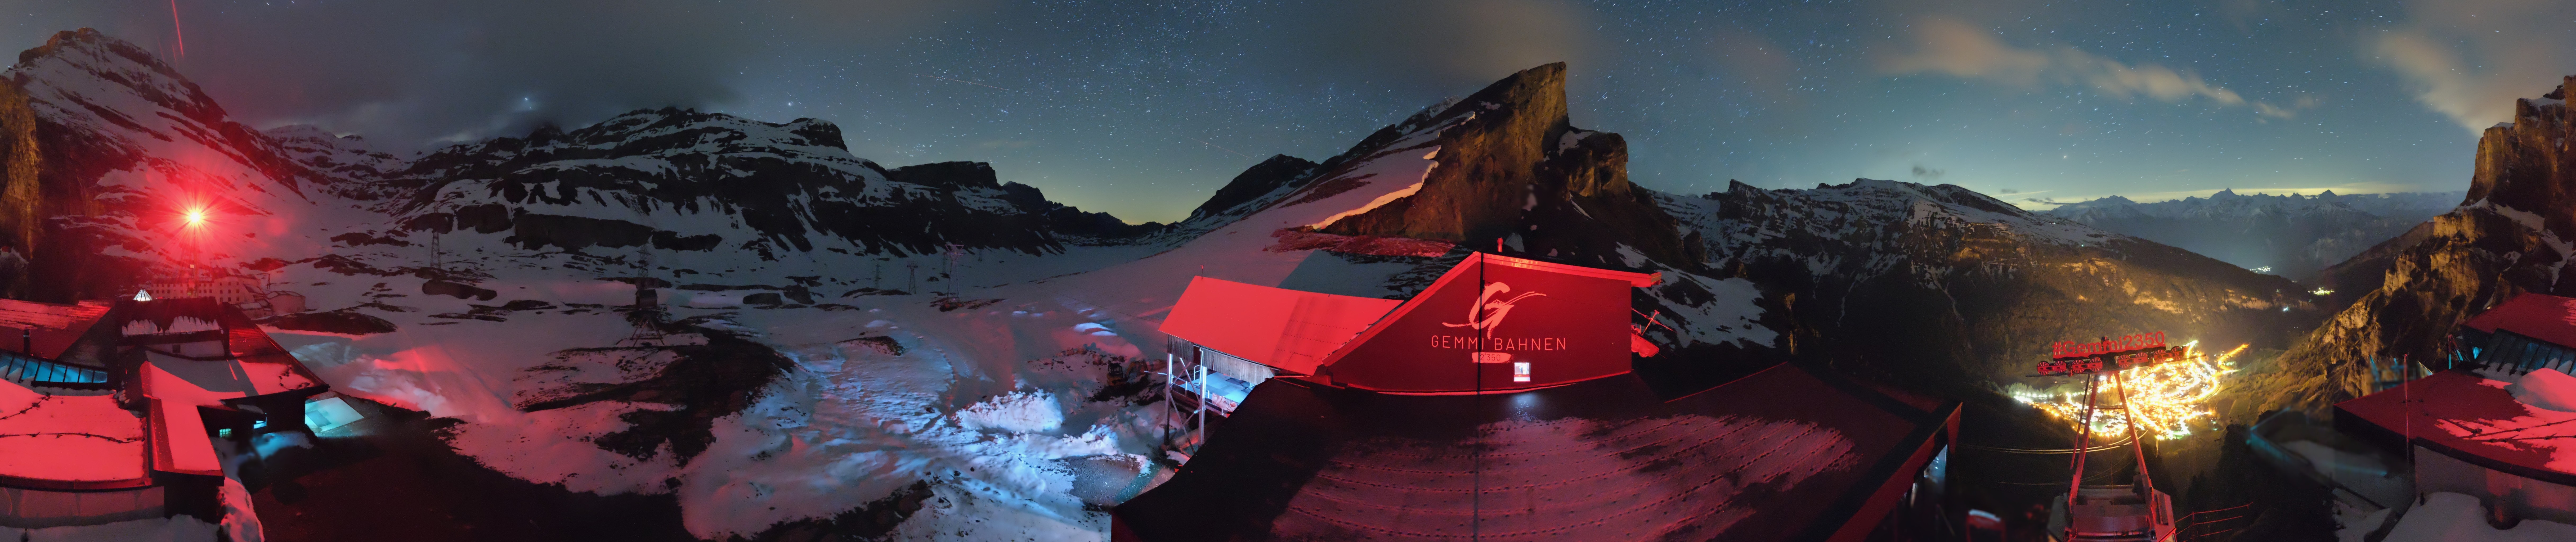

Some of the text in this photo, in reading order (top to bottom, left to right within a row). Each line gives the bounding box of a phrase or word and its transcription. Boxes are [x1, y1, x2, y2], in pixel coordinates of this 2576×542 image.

[1431, 335, 1565, 350] GEMMI BAHNEN
[2052, 331, 2165, 355] #Gemmi2350
